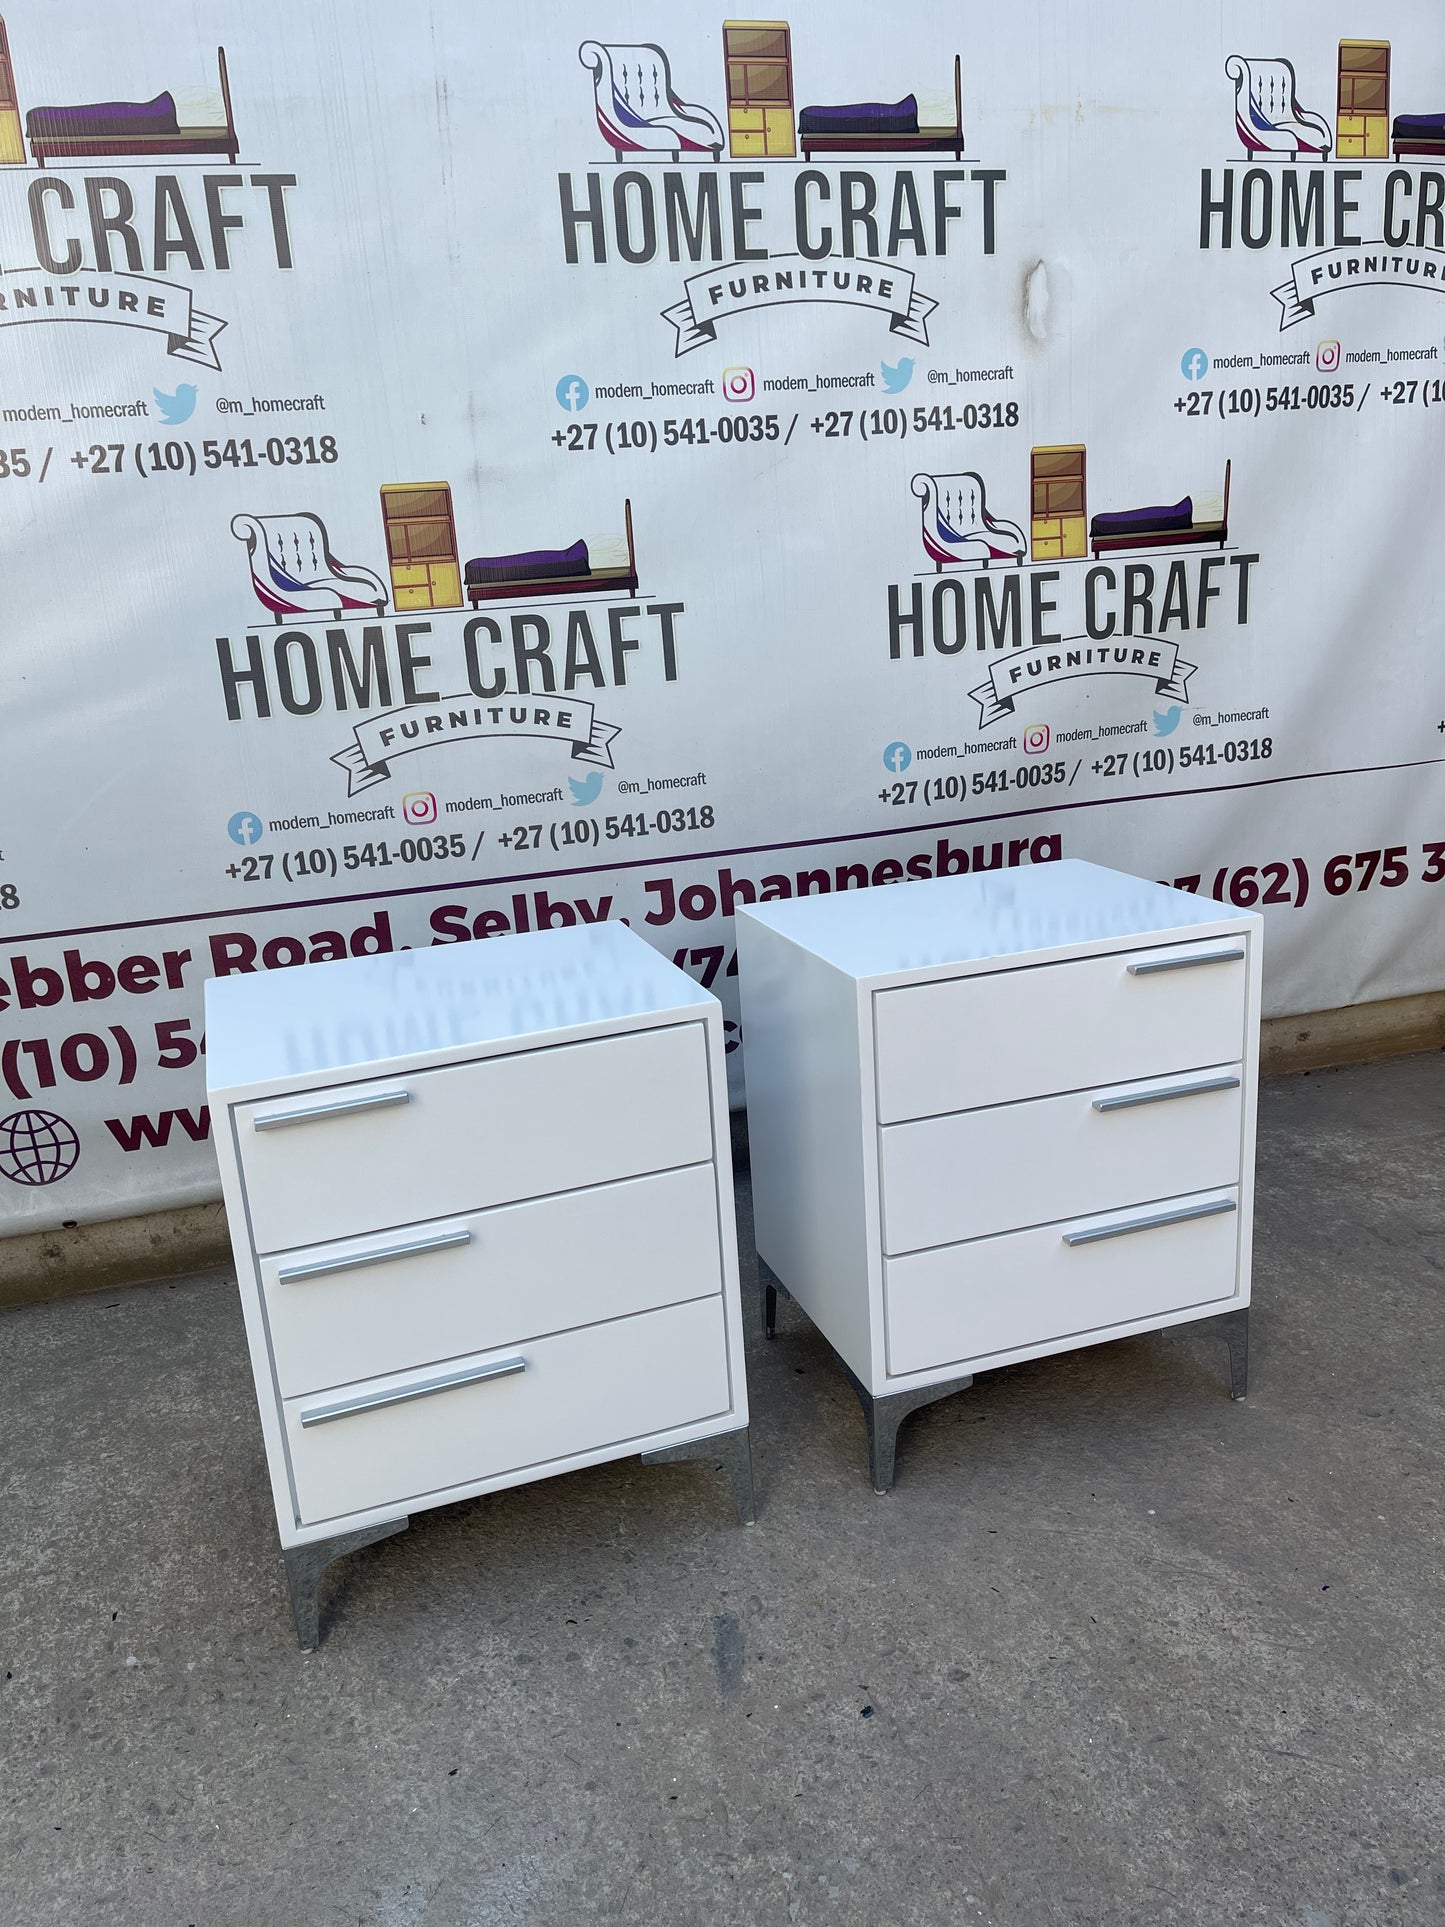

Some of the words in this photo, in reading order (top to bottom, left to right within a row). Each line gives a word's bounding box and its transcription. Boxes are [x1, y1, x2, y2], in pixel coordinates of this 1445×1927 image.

[28, 174, 297, 274] CRAFT
[558, 171, 768, 264] HOME
[795, 170, 1006, 260] CRAFT
[1200, 168, 1362, 249] HOME
[708, 270, 894, 305] FURNITURE
[928, 366, 1013, 385] @m_homecraft
[1174, 391, 1213, 416] +27
[1219, 389, 1260, 419] (10)
[1266, 384, 1354, 411] 541-0035
[1381, 381, 1418, 404] +27
[1423, 380, 1445, 407] (1
[216, 395, 325, 416] @m_homecraft
[552, 424, 597, 450] +27
[606, 421, 657, 454] (10)
[664, 415, 779, 445] 541-0035
[811, 411, 853, 437] +27
[860, 409, 907, 441] (10)
[913, 402, 1019, 432] 541-0318
[71, 444, 125, 473] +27
[135, 442, 196, 478] (10)
[203, 436, 338, 468] 541-0318
[888, 571, 1062, 660] HOME
[1085, 554, 1260, 641] CRAFT
[216, 622, 441, 722] HOME
[463, 602, 685, 700] CRAFT
[1009, 647, 1162, 684] FURNITURE
[379, 707, 574, 747] FURNITURE
[1193, 707, 1269, 726] @m_homecraft
[618, 772, 706, 794] @m_homecraft
[879, 781, 918, 805] +27
[924, 776, 966, 806] (10)
[972, 762, 1065, 794] 541-0035
[1092, 754, 1128, 776] +27
[1133, 749, 1174, 777] (10)
[1180, 738, 1272, 767] 541-0318
[226, 855, 274, 881] +27
[283, 848, 337, 882] (10)
[344, 834, 465, 869] 541-0035
[498, 825, 542, 850] +27
[550, 819, 599, 851] (10)
[606, 806, 714, 839] 541-0318
[1213, 858, 1309, 908] (62)
[1324, 846, 1408, 895] 675
[0, 949, 192, 1012] bber
[209, 911, 413, 977] Road
[2, 1026, 137, 1100] (10)
[155, 1019, 205, 1068] 5
